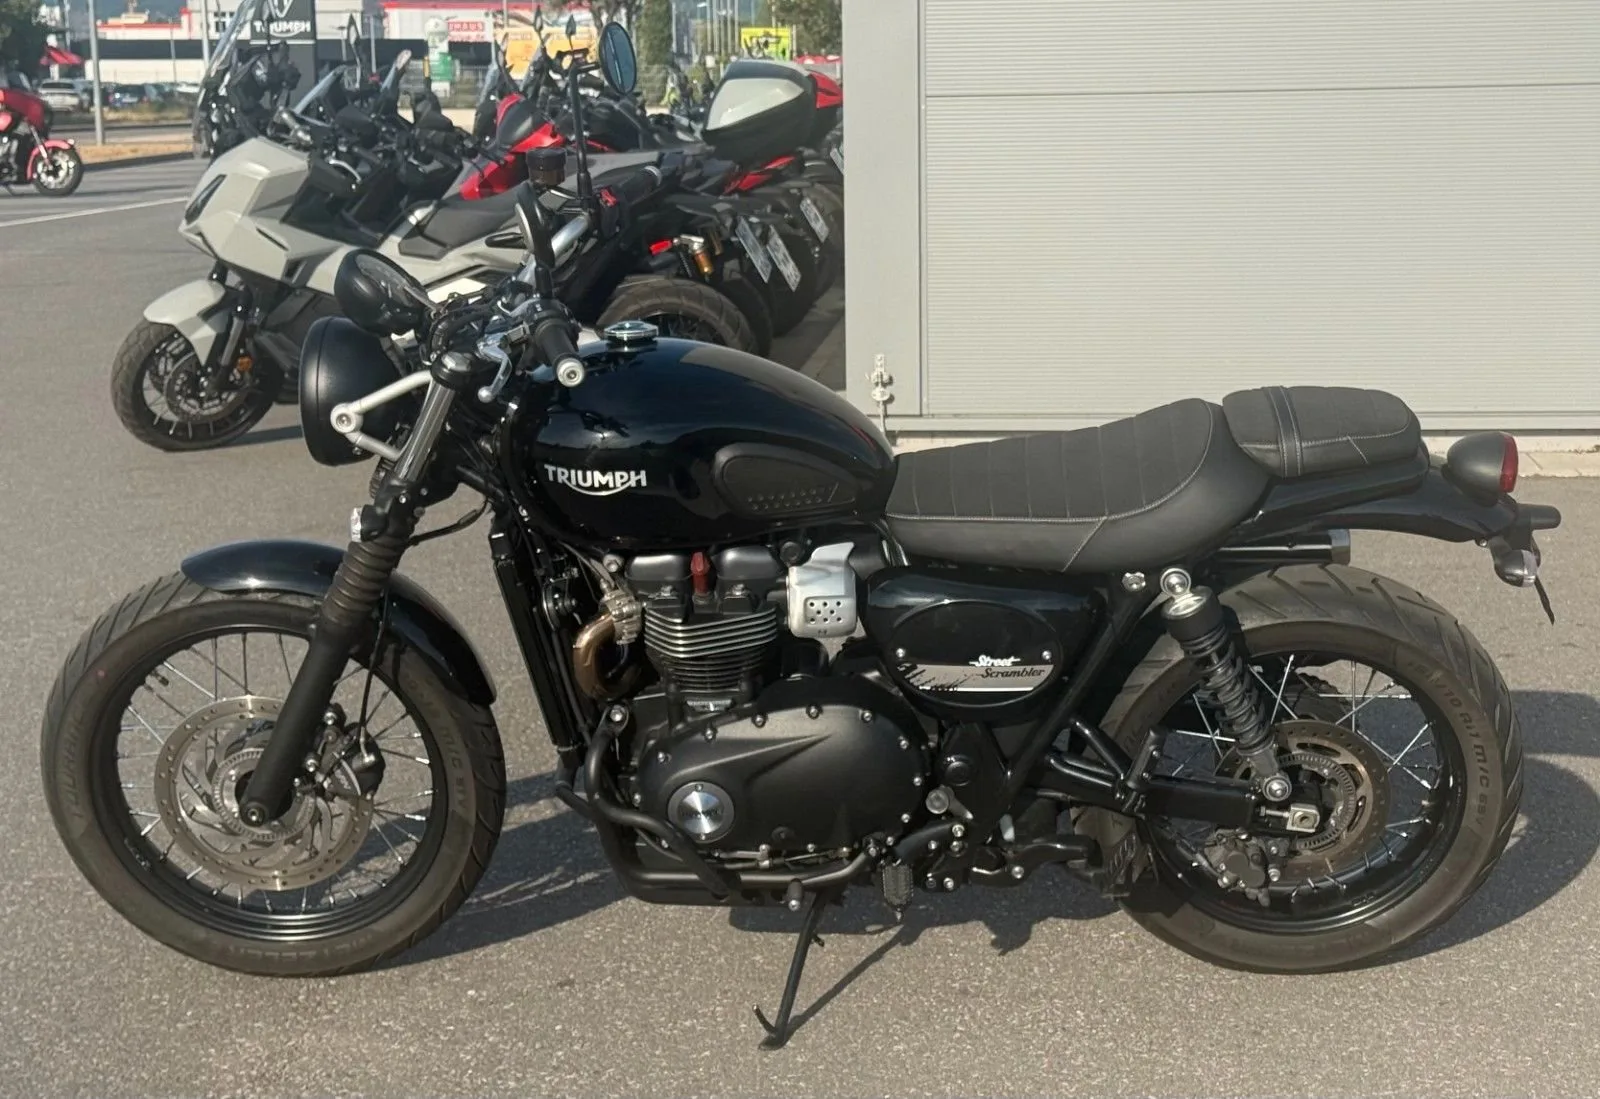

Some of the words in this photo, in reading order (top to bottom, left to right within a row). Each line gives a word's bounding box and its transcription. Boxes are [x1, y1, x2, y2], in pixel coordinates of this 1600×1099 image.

[543, 463, 648, 496] TRIUMPH
[969, 654, 1021, 667] Street
[975, 667, 1046, 679] Scrambler
